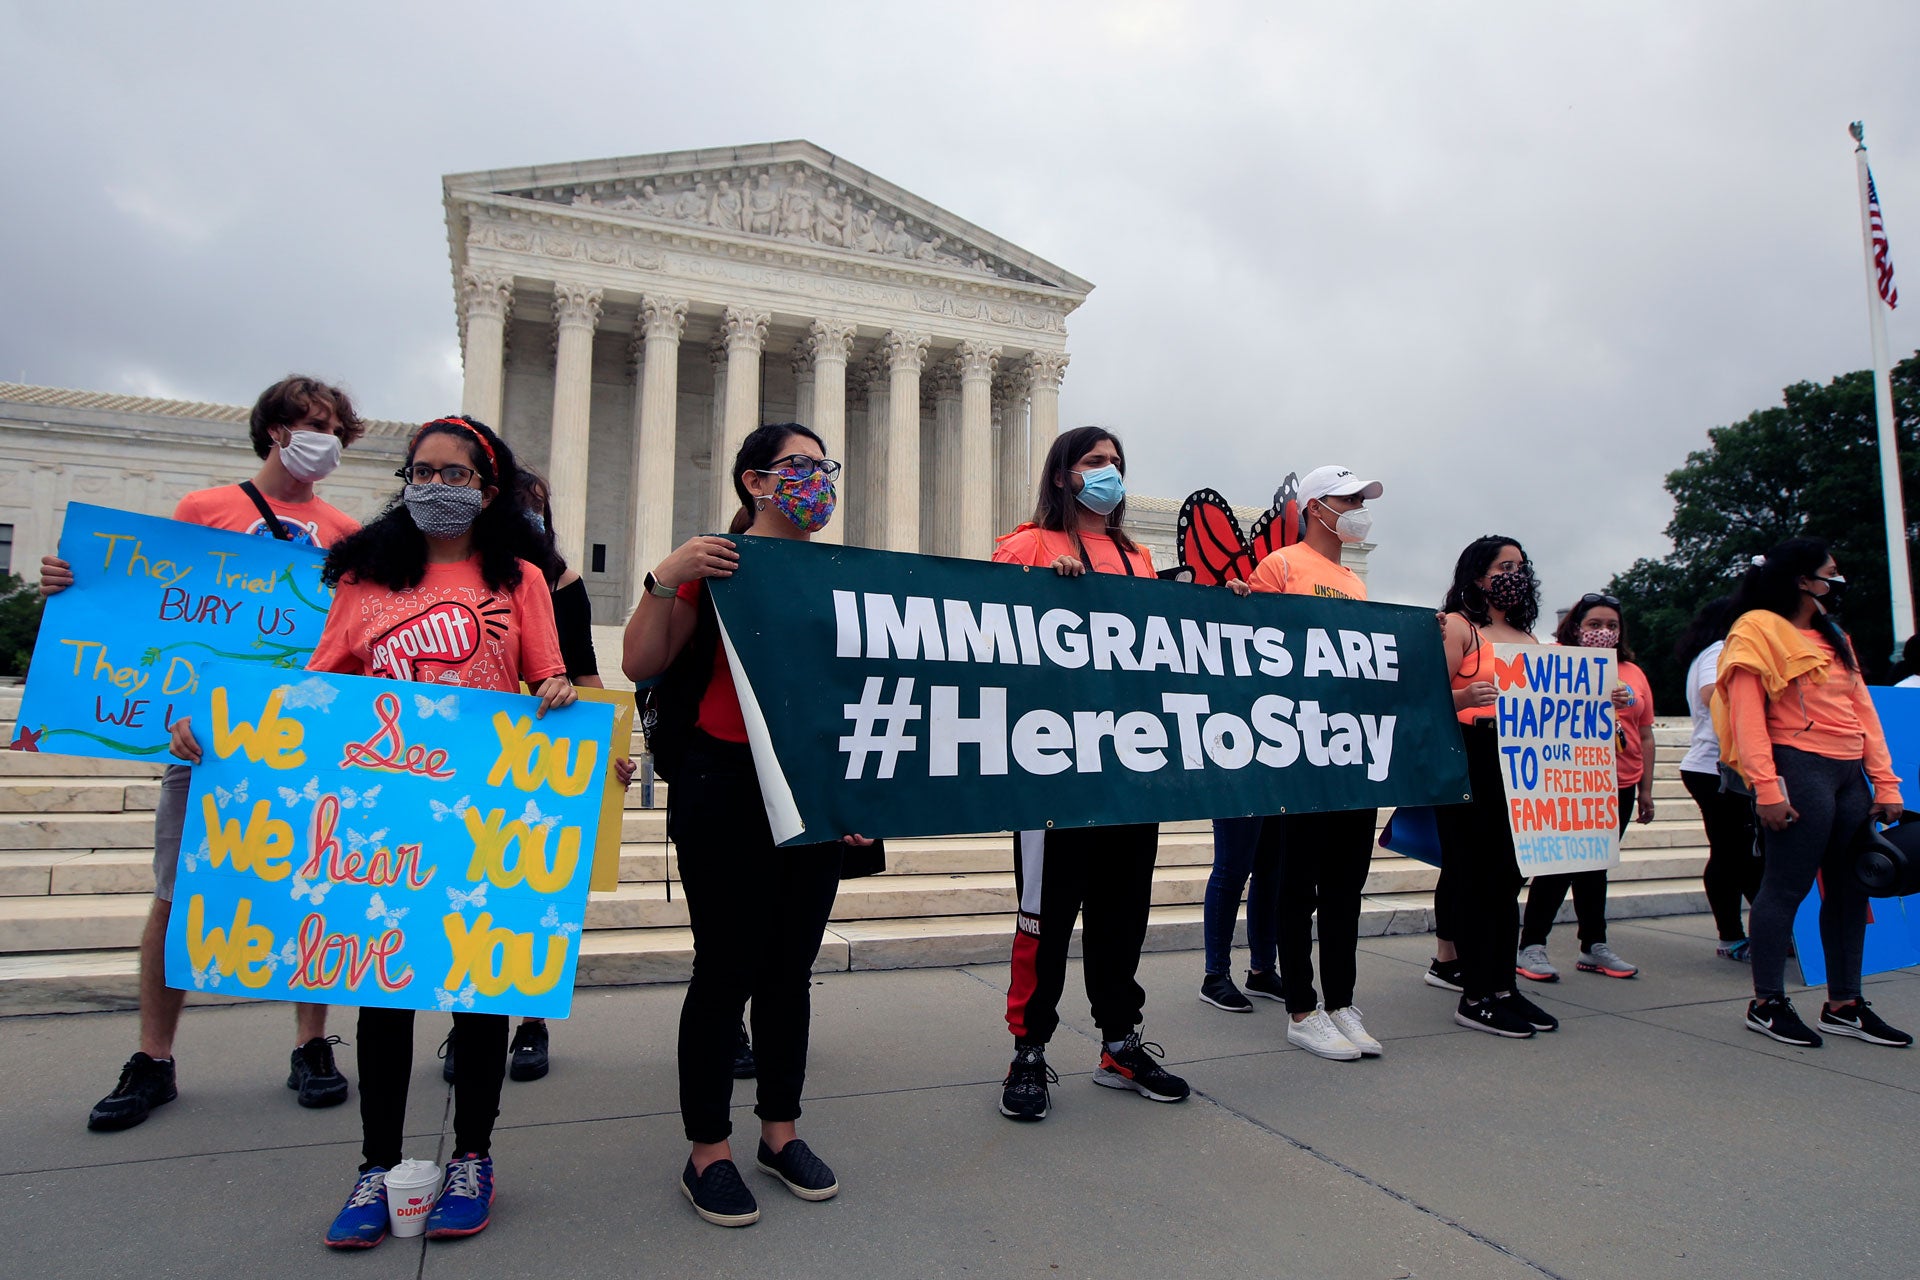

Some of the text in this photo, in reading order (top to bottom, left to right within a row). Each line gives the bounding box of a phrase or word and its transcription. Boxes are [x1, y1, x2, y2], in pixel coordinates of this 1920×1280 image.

[679, 258, 737, 279] EQUAL
[813, 278, 866, 299] UNDER
[872, 286, 903, 303] LAW
[94, 532, 193, 588] They
[208, 551, 276, 593] Tried
[159, 587, 296, 635] BURY US
[832, 589, 1400, 682] IMMIGRANTS ARE
[60, 639, 149, 697] They
[1523, 652, 1608, 696] WHAT
[95, 696, 150, 728] WE
[211, 685, 306, 769] We
[339, 692, 456, 778] See
[838, 676, 1397, 782] #HereToStay
[1499, 696, 1613, 740] HAPPENS
[1501, 746, 1538, 790] TO
[1542, 743, 1571, 761] OUR
[1510, 795, 1618, 833] FAMILIES
[202, 793, 295, 882] We
[300, 793, 436, 889] hear
[1519, 836, 1610, 865] #HERETOSTAY
[186, 893, 275, 989] We
[288, 911, 413, 990] love
